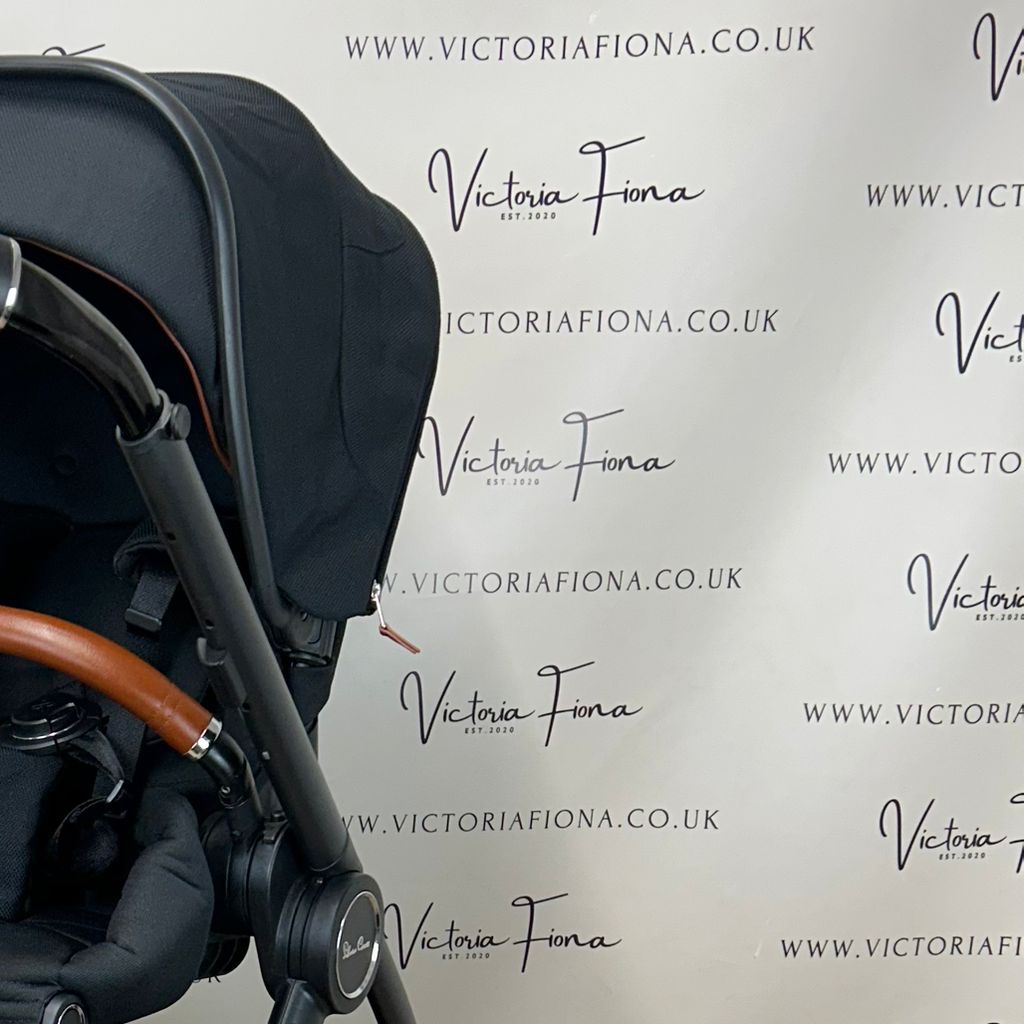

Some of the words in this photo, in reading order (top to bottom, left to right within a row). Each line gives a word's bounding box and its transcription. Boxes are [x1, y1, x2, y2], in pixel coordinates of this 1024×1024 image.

[346, 26, 816, 61] WWW.VICTORIAFIONA.CO.UK
[428, 147, 579, 233] Victoria
[579, 137, 707, 236] Fiona
[501, 212, 557, 221] EST.2020
[417, 416, 562, 497] Victoria
[562, 409, 677, 502] Fiona
[487, 478, 540, 486] EST.2020
[400, 671, 537, 744] Victoria
[537, 661, 643, 747] Fiona
[465, 727, 515, 735] EST.2020
[879, 798, 1007, 871] Victoria
[939, 852, 986, 860] EST.2020
[385, 903, 512, 970] Victoria
[512, 893, 623, 973] Fiona
